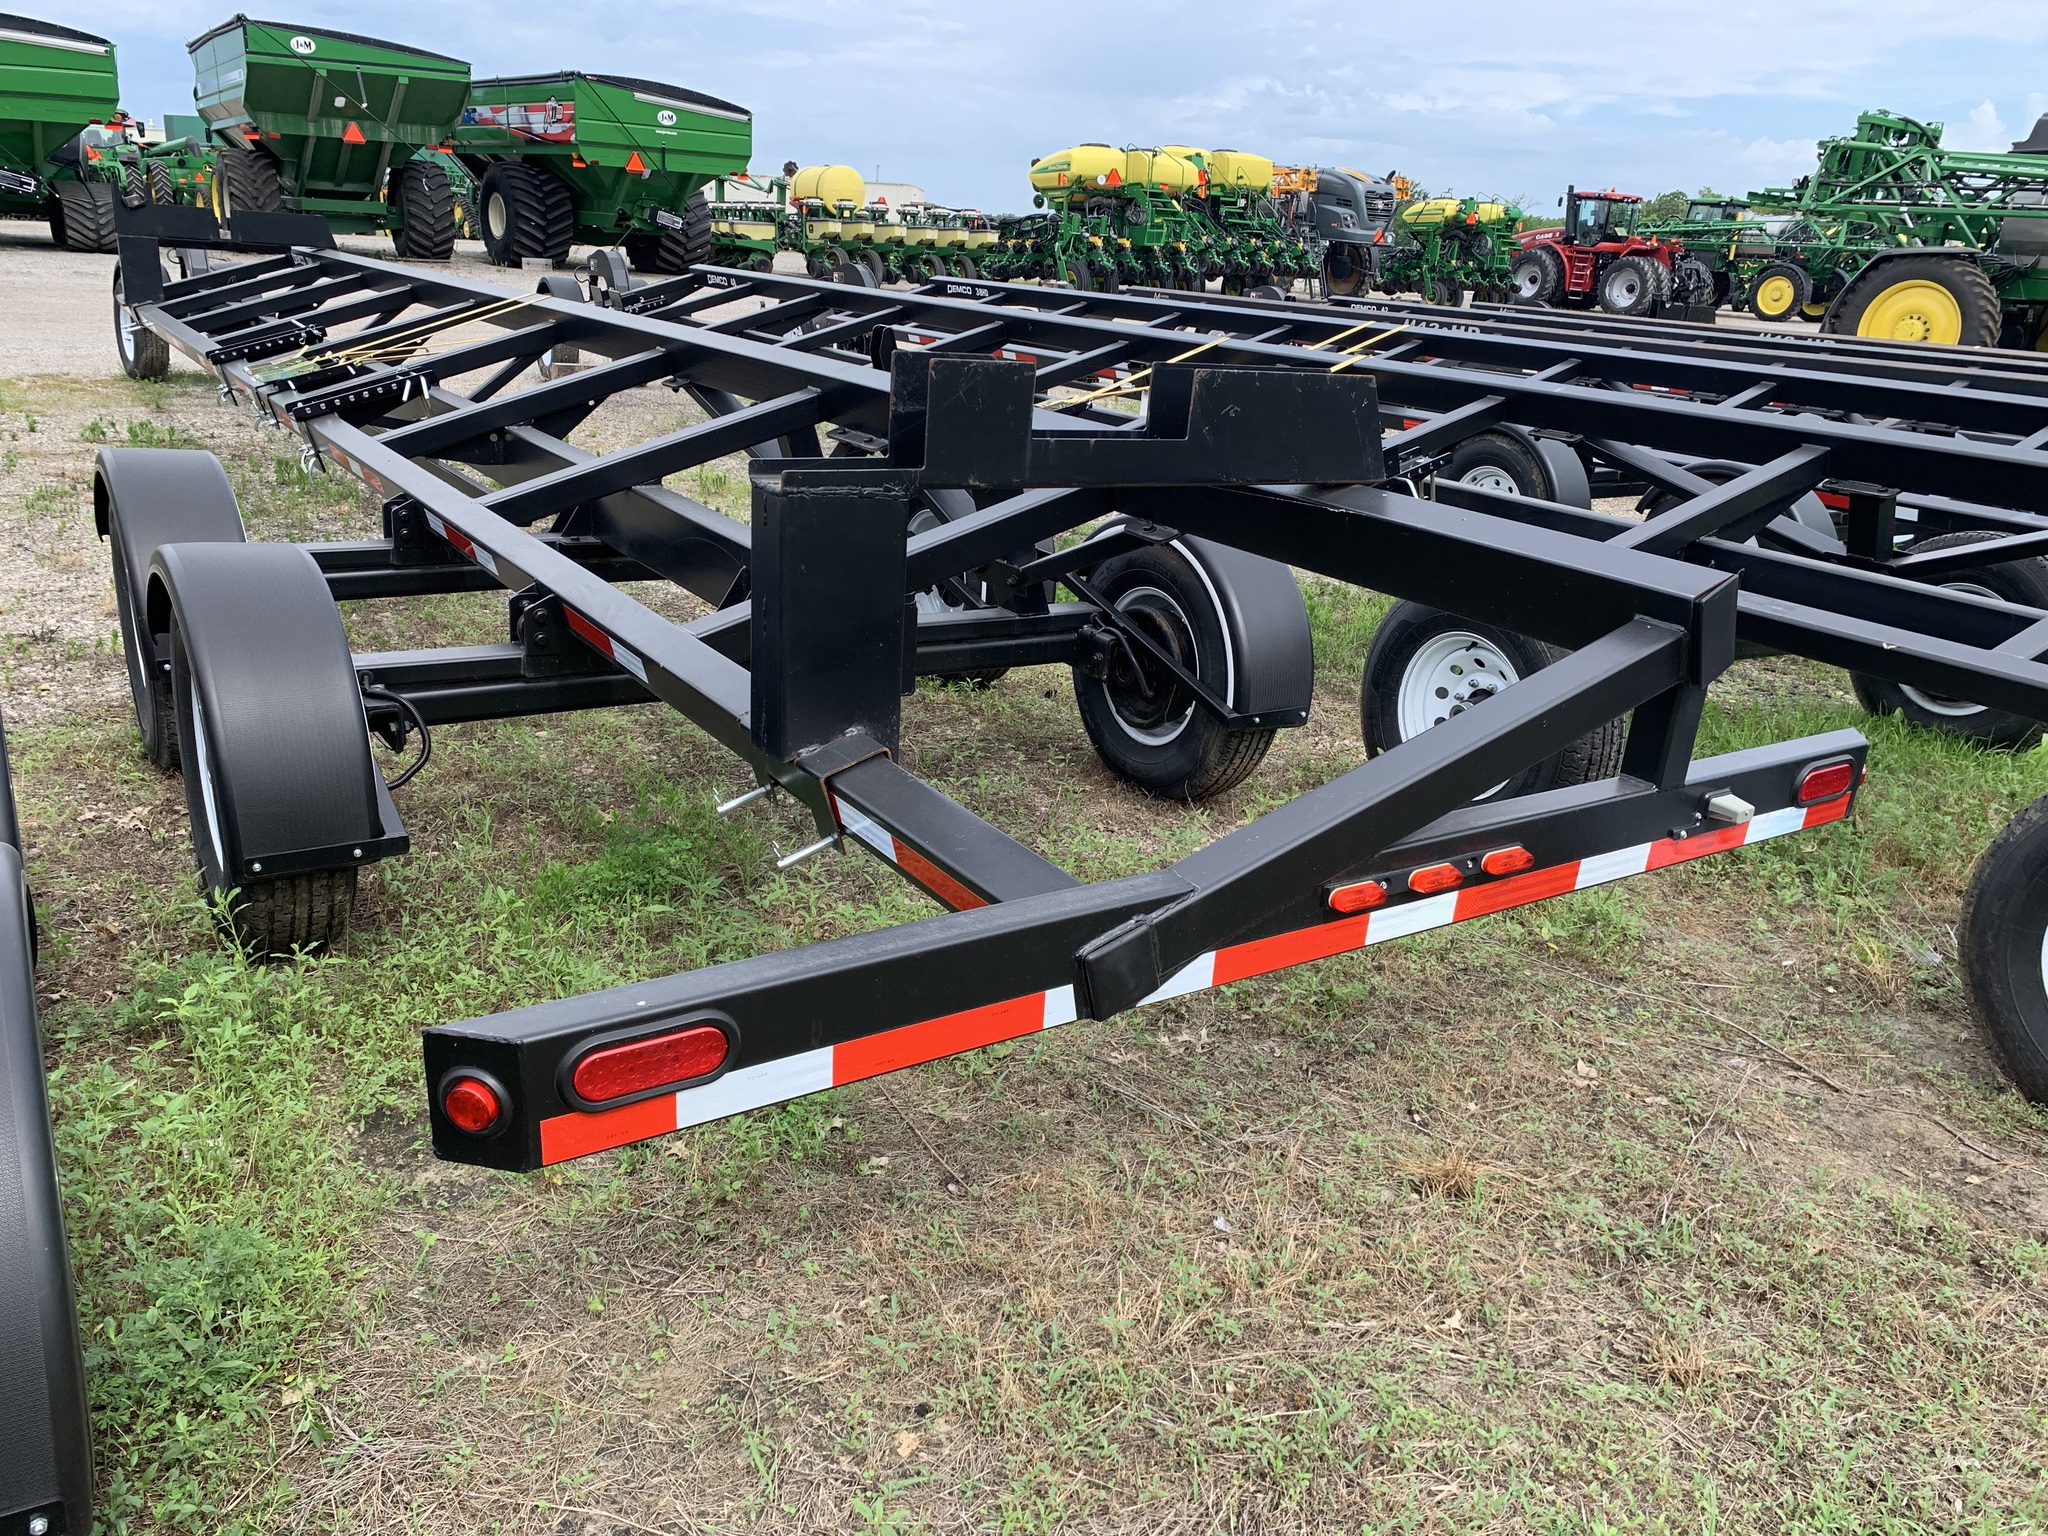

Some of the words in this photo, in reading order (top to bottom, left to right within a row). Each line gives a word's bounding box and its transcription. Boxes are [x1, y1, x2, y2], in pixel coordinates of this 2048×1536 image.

[293, 40, 312, 50] J&M
[659, 113, 674, 123] J&M
[1535, 232, 1554, 240] CASE
[707, 274, 728, 286] DEMCO
[947, 284, 973, 295] DEMCO
